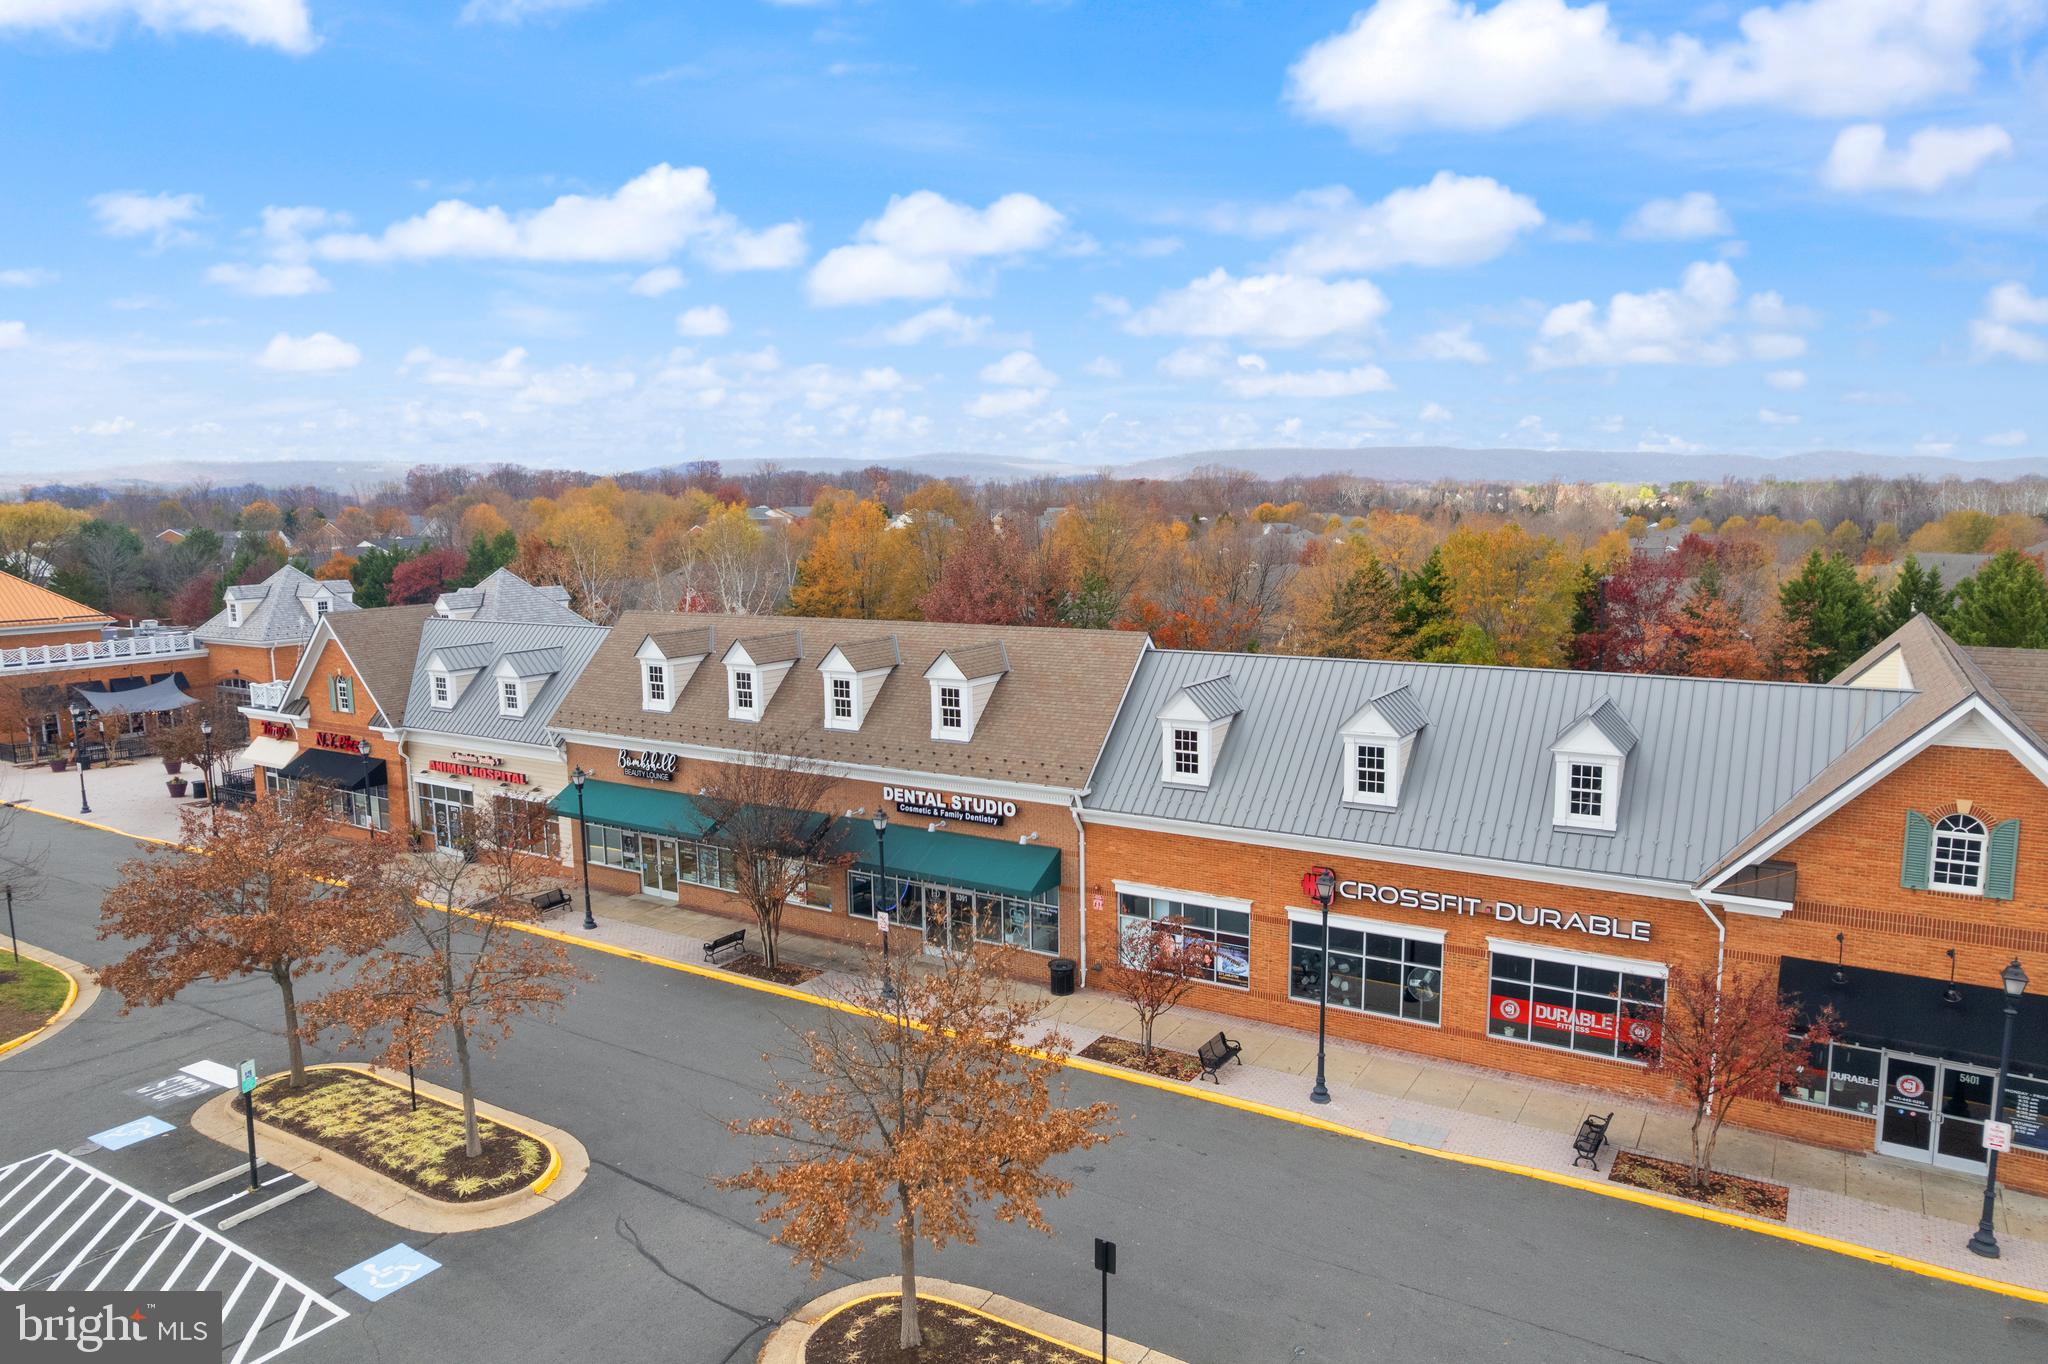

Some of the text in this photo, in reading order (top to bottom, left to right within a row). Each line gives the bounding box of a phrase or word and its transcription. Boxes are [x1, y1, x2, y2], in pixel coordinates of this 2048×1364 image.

[337, 735, 361, 753] Pizz
[617, 749, 676, 772] Bombshell
[428, 760, 528, 785] ANIMAL HOSPITAL
[624, 768, 670, 781] BEAUTY LOUNGE
[883, 786, 1017, 817] DENTAL STUDIO
[899, 804, 998, 826] Cosmetic & Family Dentistry
[1339, 880, 1652, 943] CROSSFIT DURABLE
[1535, 1004, 1613, 1031] DURABLE
[135, 1075, 211, 1102] STOP
[1830, 1071, 1880, 1088] DURABLE
[1959, 1073, 1980, 1085] 5401
